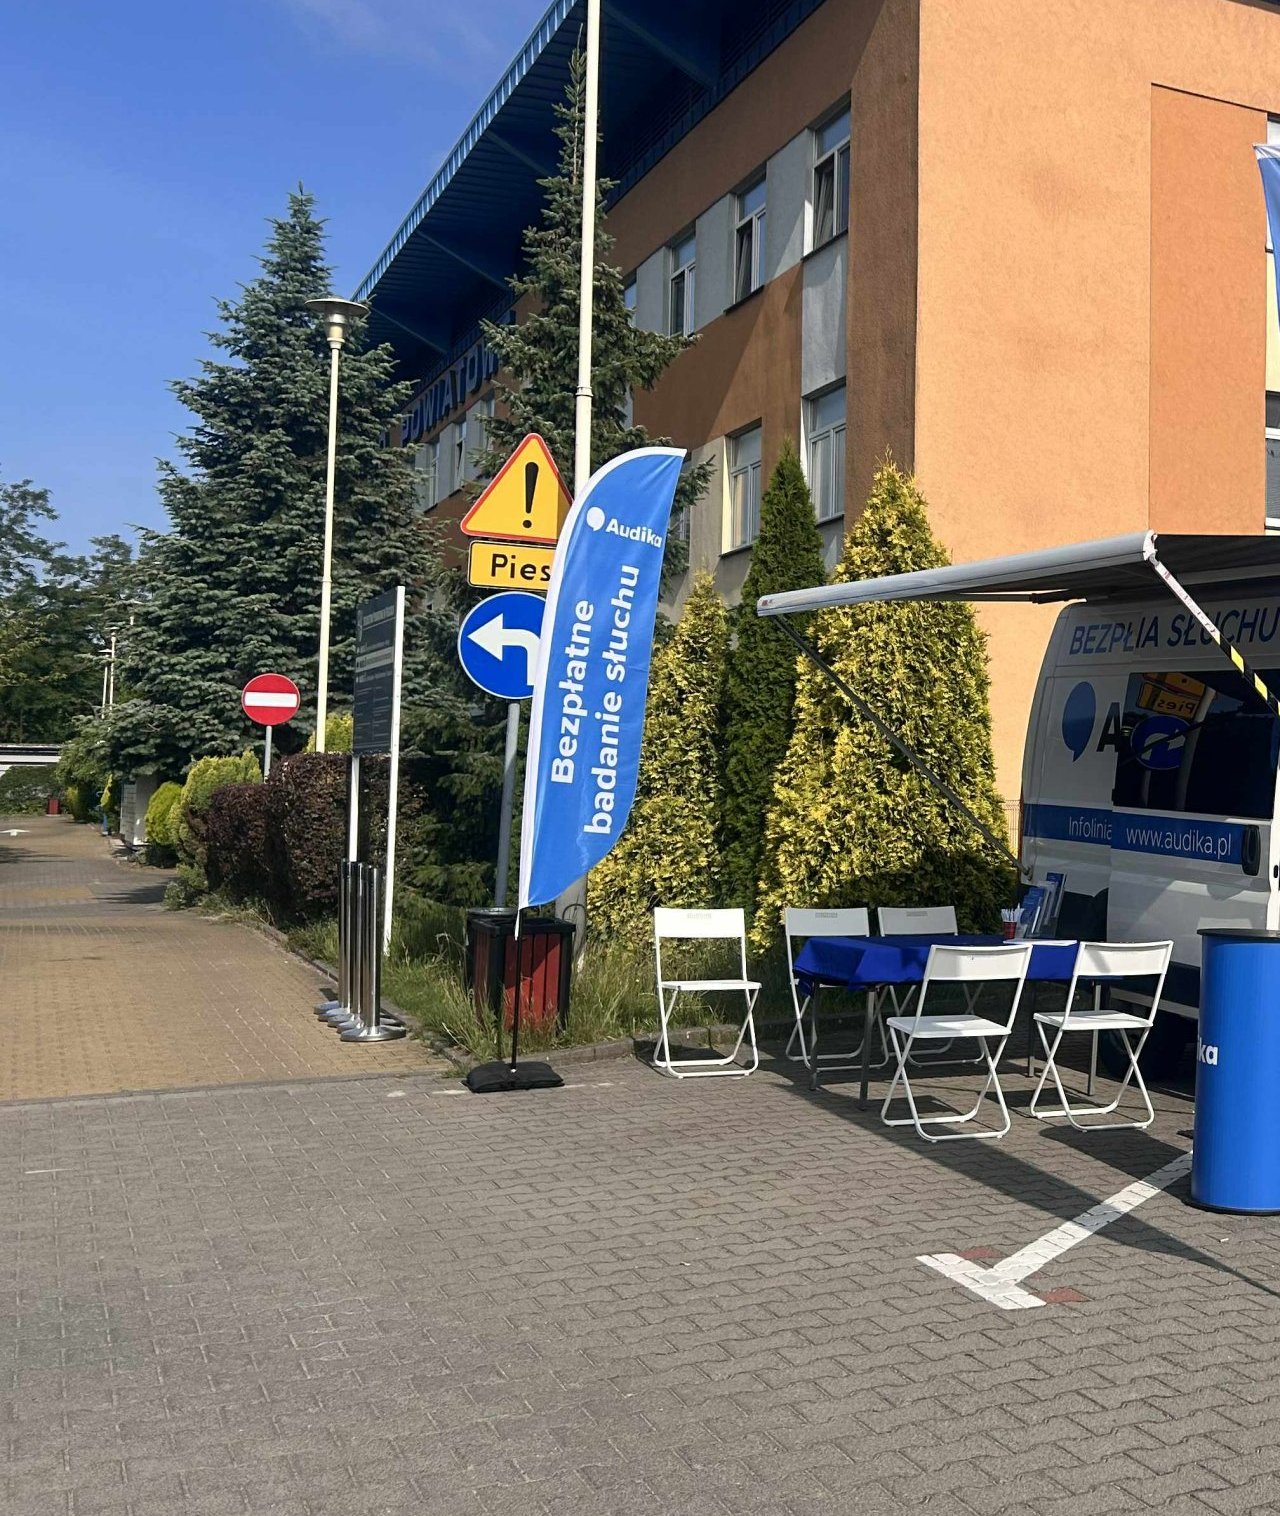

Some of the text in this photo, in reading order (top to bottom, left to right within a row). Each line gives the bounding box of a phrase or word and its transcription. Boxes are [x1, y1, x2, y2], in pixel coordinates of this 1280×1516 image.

[605, 518, 663, 549] Audika
[551, 600, 595, 784] Bezpłatne
[584, 564, 640, 835] badanie słuchu
[1126, 827, 1231, 860] www.audika.pl
